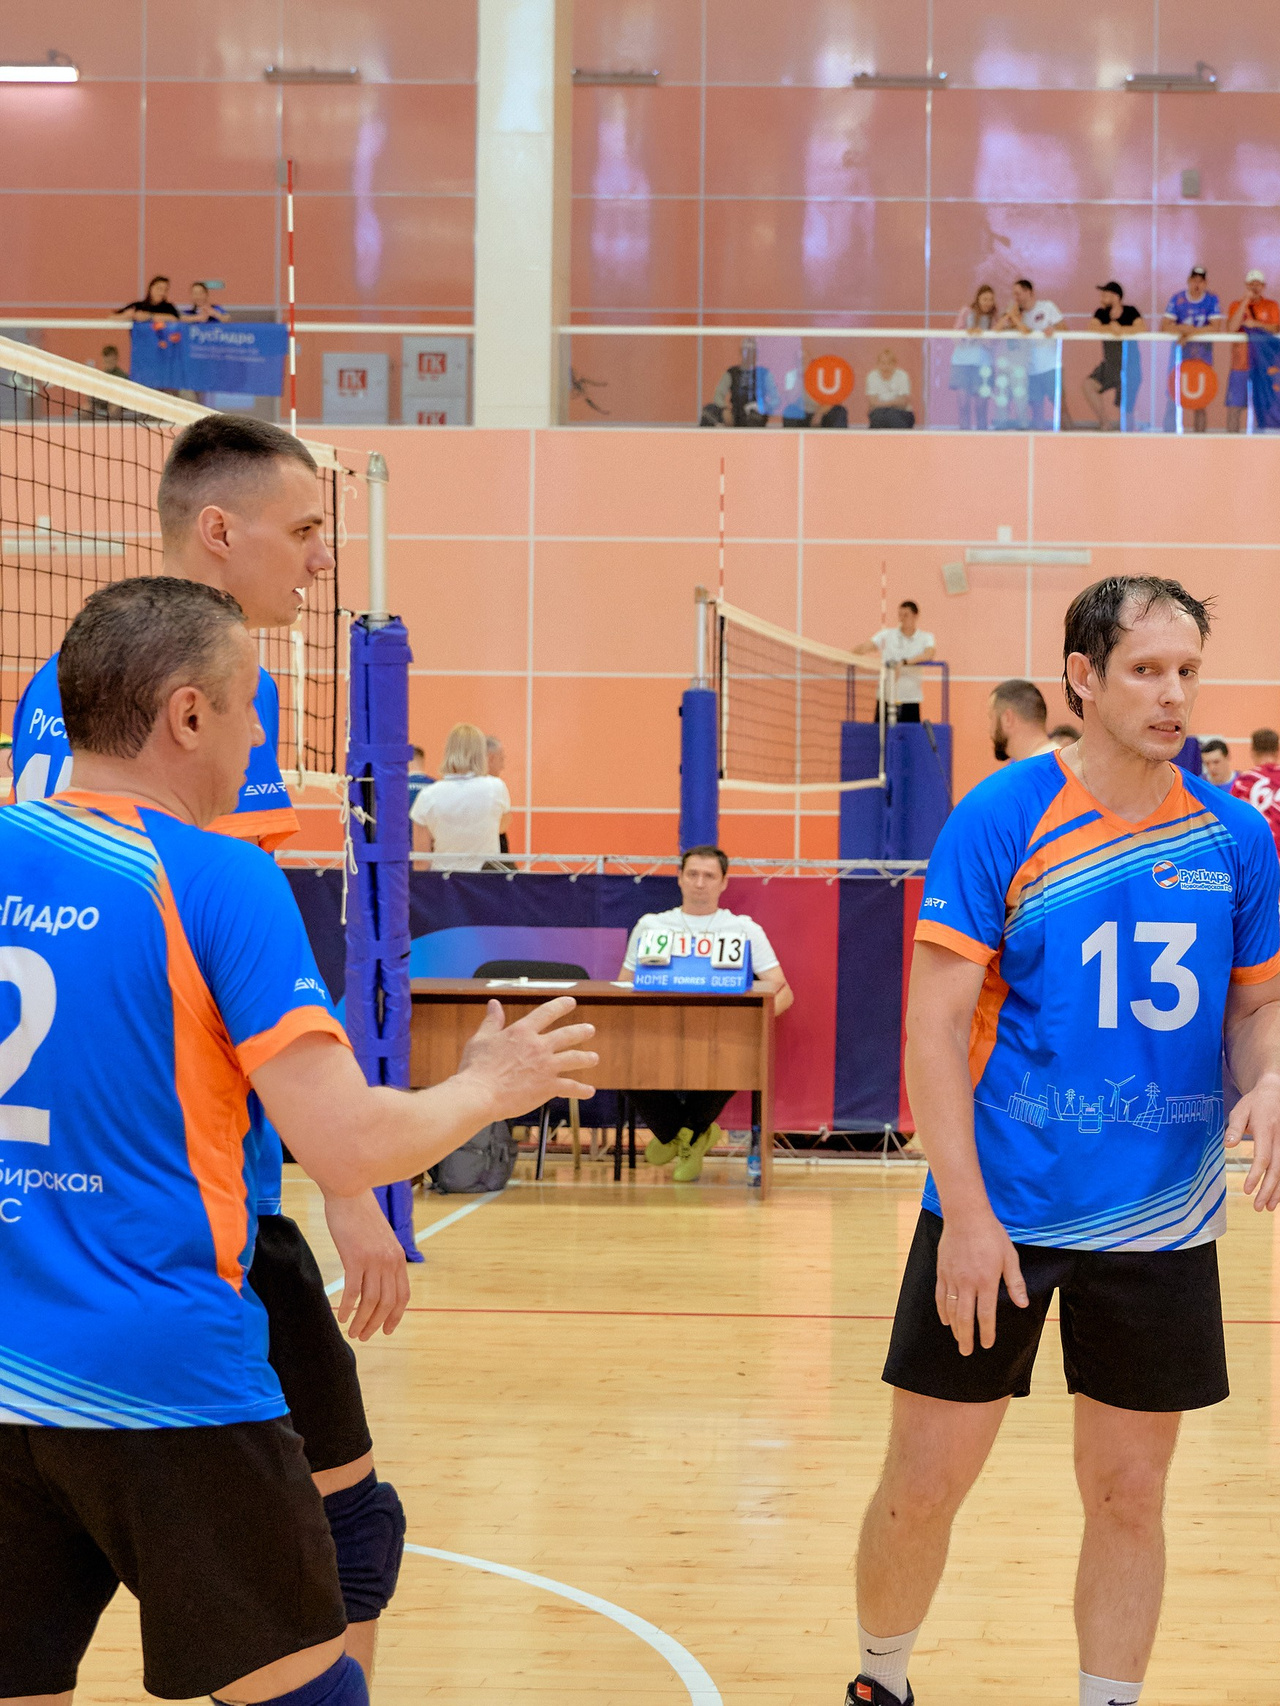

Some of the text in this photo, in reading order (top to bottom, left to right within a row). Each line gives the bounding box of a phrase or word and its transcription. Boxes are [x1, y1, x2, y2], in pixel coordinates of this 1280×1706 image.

[29, 708, 68, 740] Рус
[244, 781, 287, 796] SVAR
[0, 894, 100, 936] Гидро
[679, 938, 686, 954] 1
[718, 938, 741, 962] 13
[636, 974, 669, 986] HOME
[711, 975, 744, 988] GUEST
[1082, 921, 1200, 1031] 13
